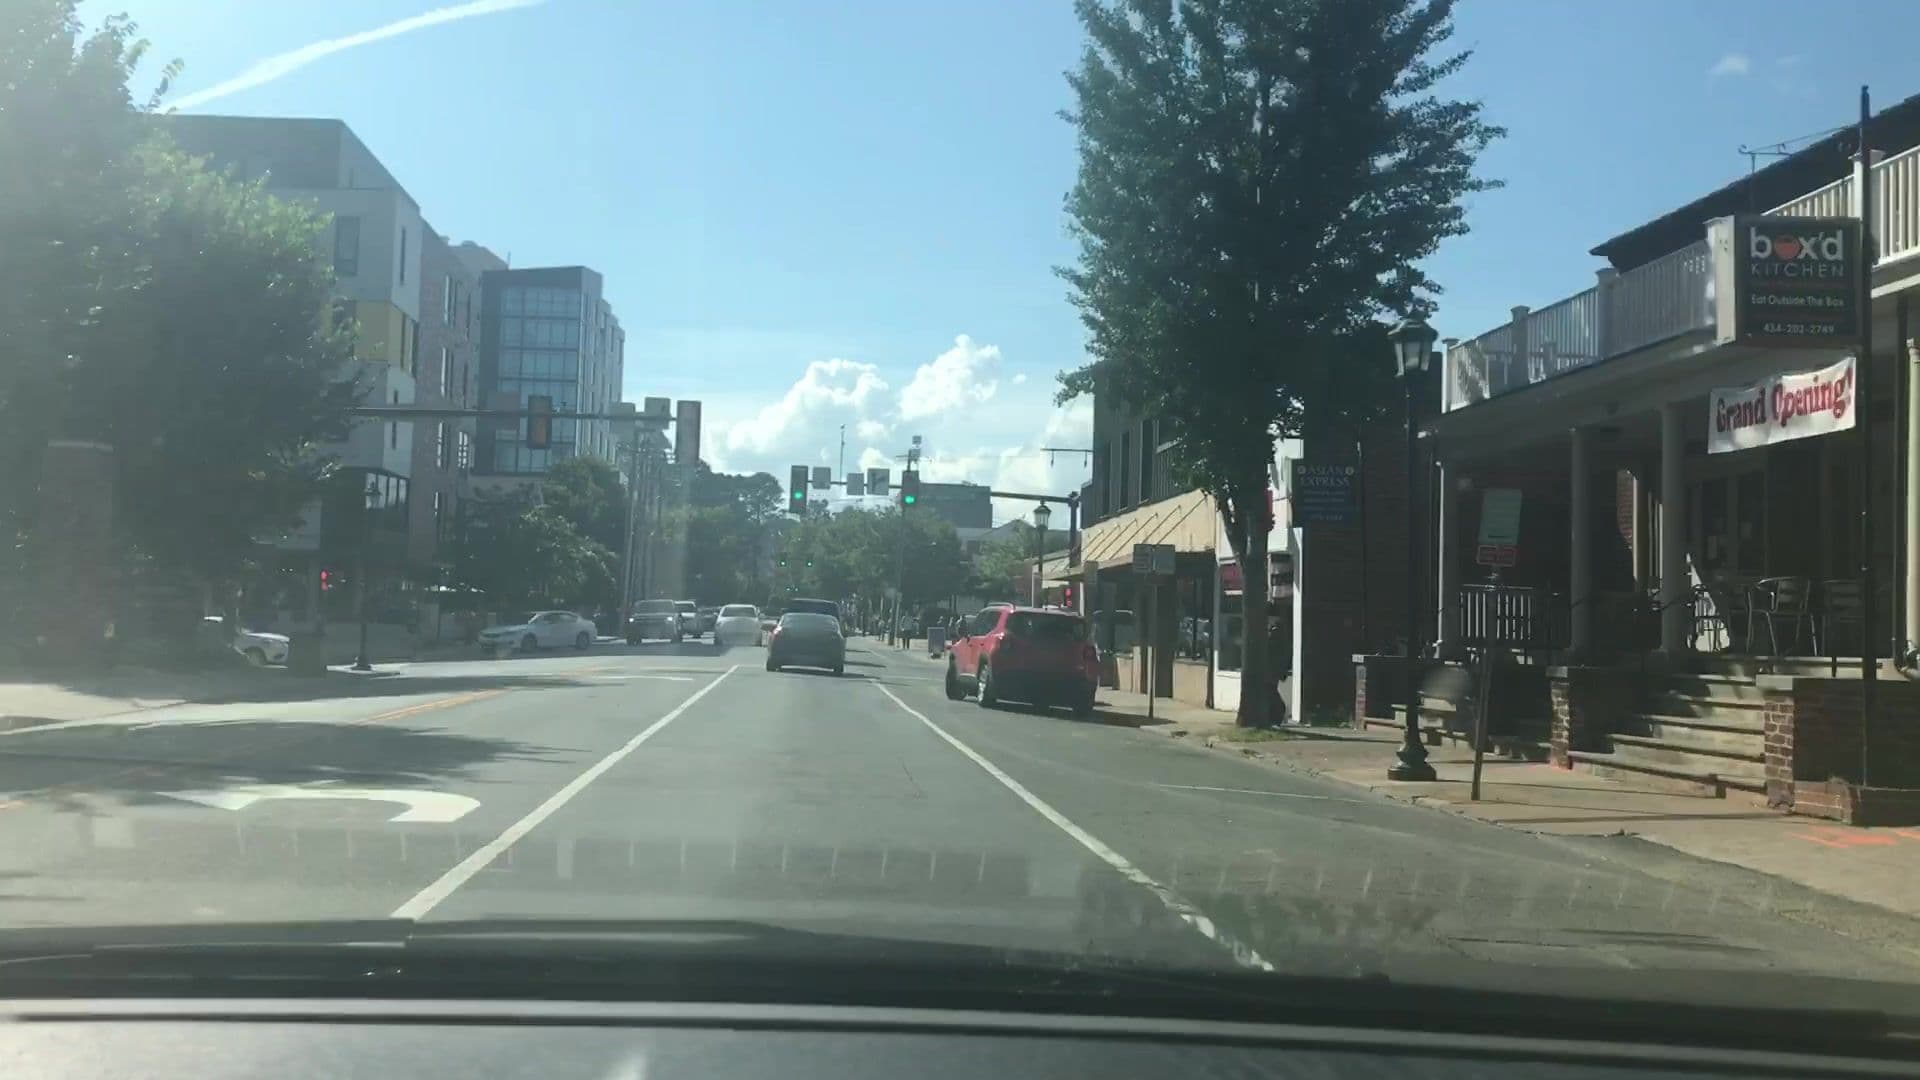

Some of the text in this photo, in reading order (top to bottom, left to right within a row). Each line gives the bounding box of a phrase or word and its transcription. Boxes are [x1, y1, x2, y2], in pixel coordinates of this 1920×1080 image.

[1751, 263, 1843, 277] KITCHEN
[1751, 294, 1844, 306] Eat Outside The Box
[1716, 367, 1854, 433] Grand Opening!
[1300, 475, 1350, 488] EXPRESS
